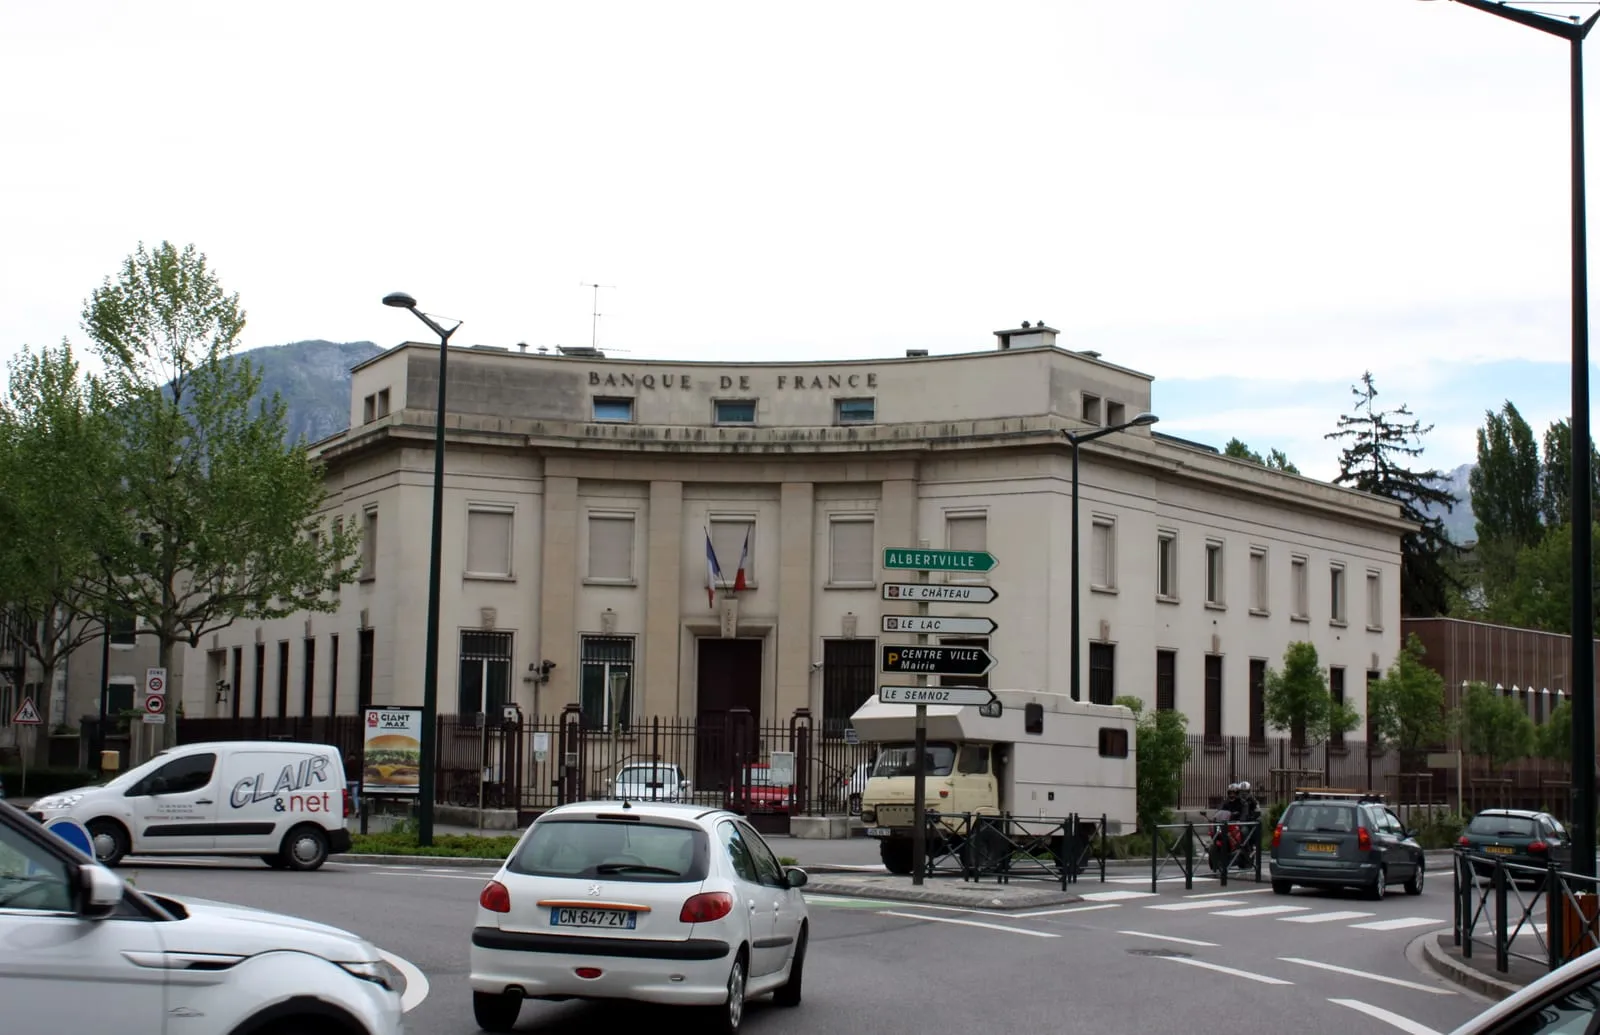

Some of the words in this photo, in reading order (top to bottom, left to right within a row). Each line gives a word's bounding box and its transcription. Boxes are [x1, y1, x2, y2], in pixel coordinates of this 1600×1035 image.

[588, 371, 692, 391] BANQUE
[719, 375, 750, 390] DE
[777, 372, 879, 390] FRANCE
[889, 553, 975, 567] ALBERTVILLE
[902, 587, 915, 597] LE
[921, 586, 970, 598] CHÂTEAU
[901, 620, 913, 629] LE
[920, 620, 941, 629] LAC
[888, 652, 898, 665] P
[901, 649, 943, 660] CENTRE
[950, 650, 979, 661] VILLE
[901, 661, 936, 671] Mairie
[885, 689, 897, 699] LE
[904, 690, 950, 701] SEMNOZ
[230, 754, 329, 809] CLAIR
[274, 798, 286, 812] &
[290, 791, 330, 812] net
